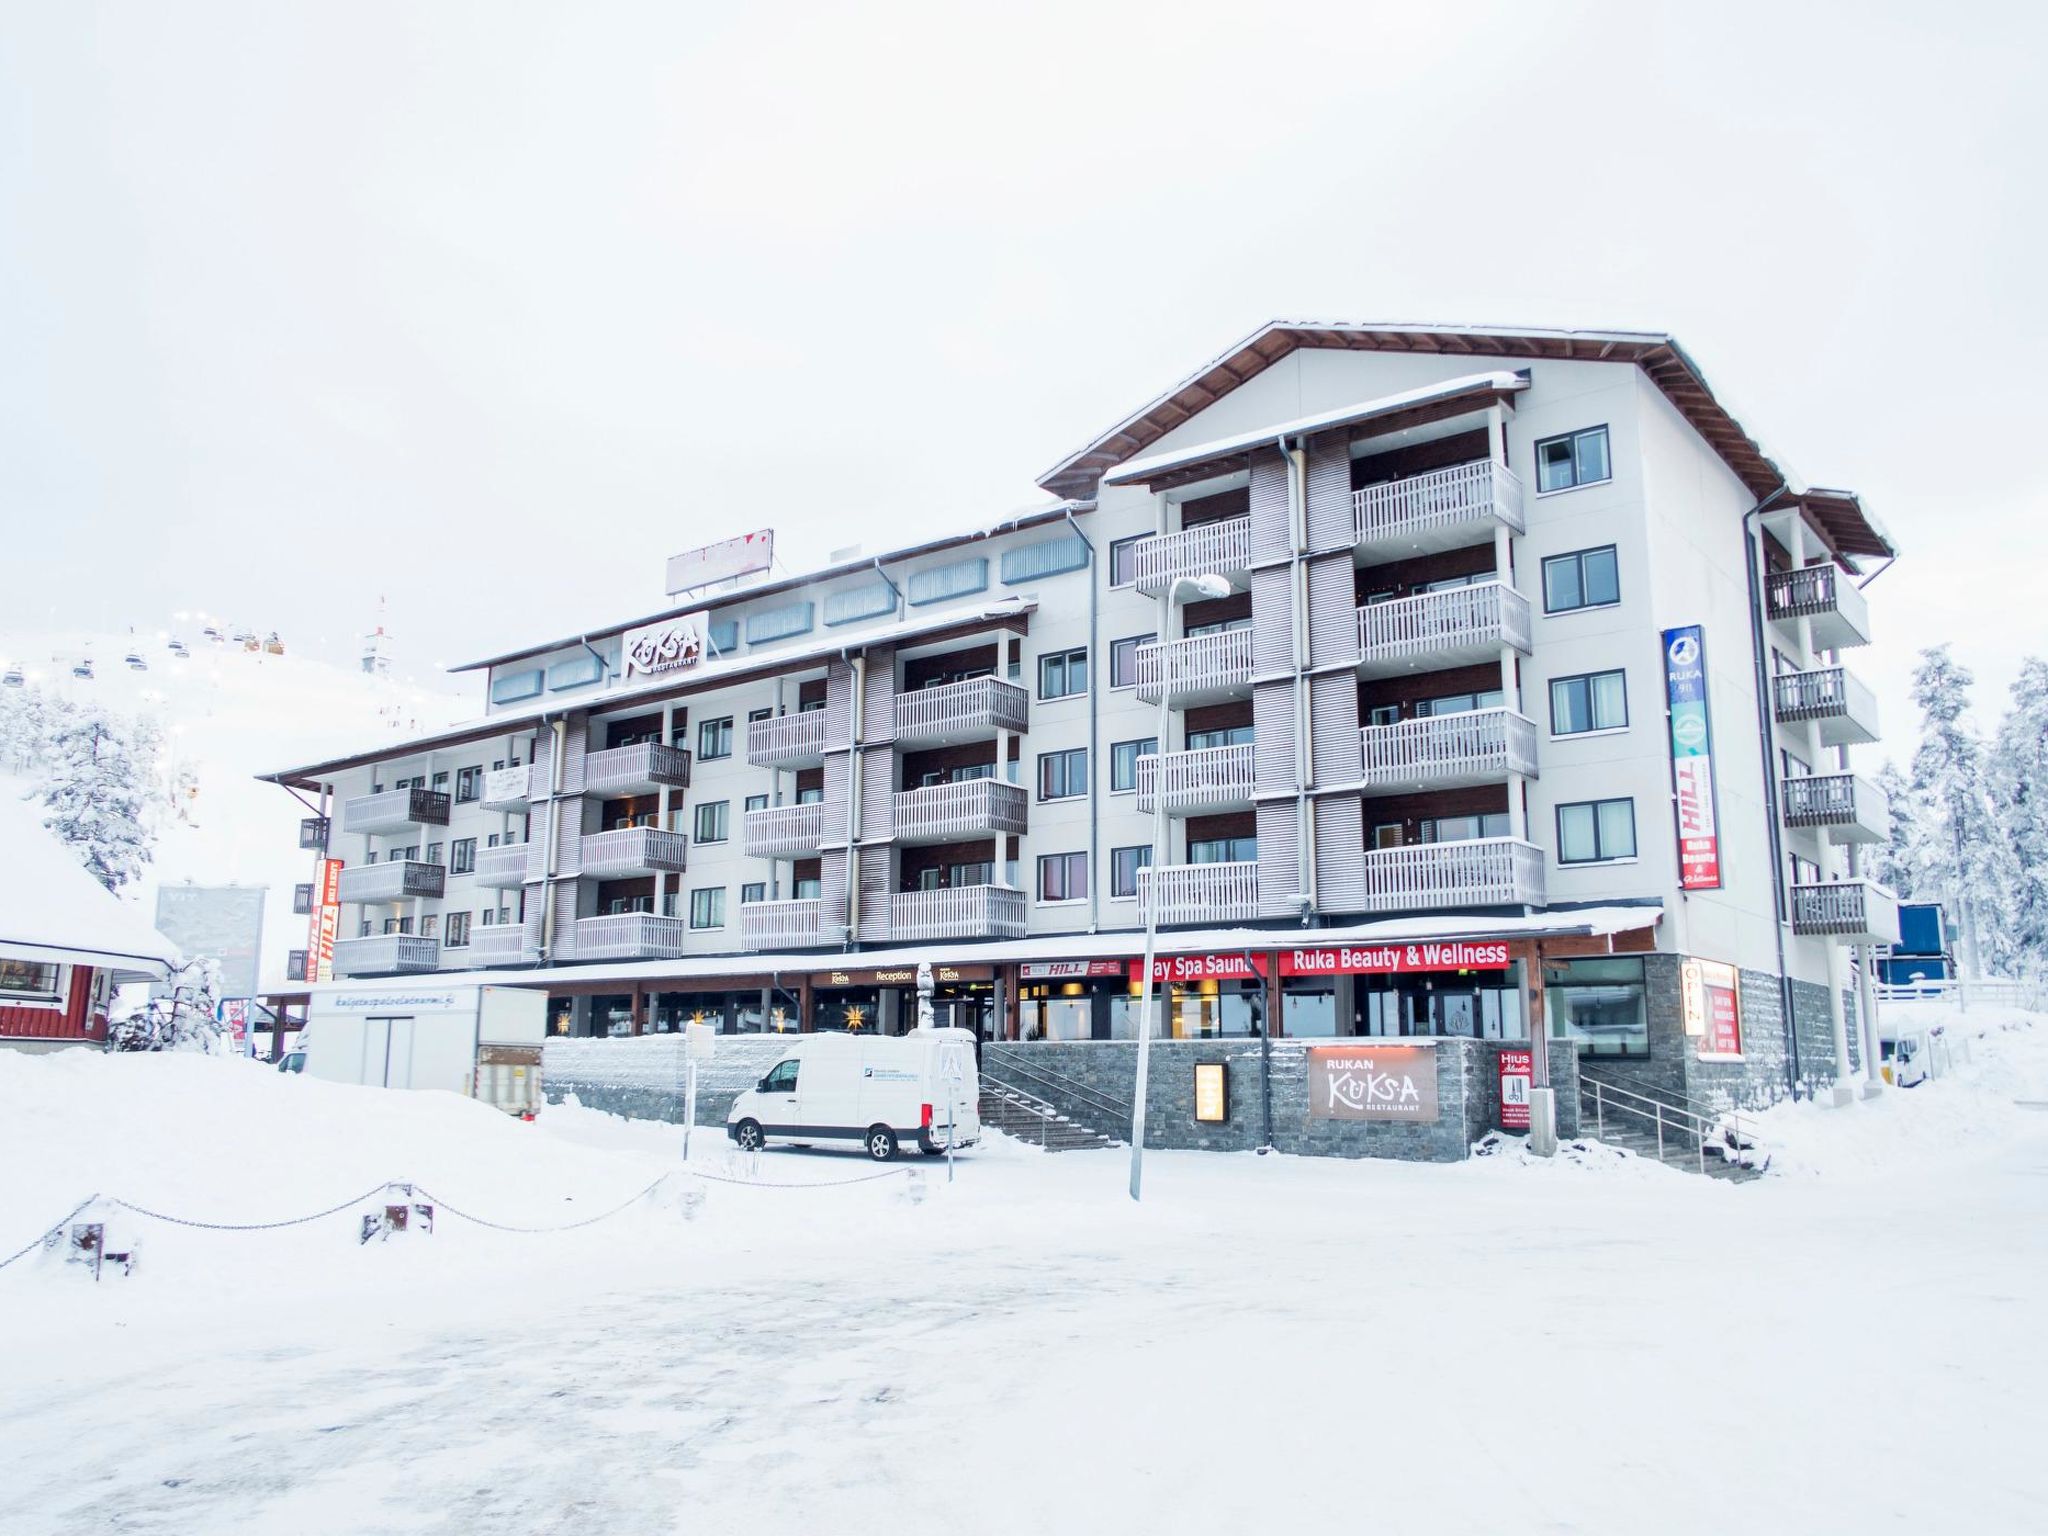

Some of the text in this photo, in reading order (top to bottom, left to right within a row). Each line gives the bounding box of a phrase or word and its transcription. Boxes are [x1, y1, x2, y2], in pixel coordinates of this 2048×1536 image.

[1669, 671, 1703, 682] RUKA
[1679, 762, 1701, 832] HILL
[321, 909, 335, 960] HILL
[1294, 943, 1507, 974] Ruka Beauty & Wellness
[1048, 963, 1083, 976] HILL
[1153, 961, 1171, 981] ay
[1175, 957, 1203, 980] Spa
[876, 970, 912, 982] Reception
[1326, 1059, 1374, 1070] RUKAN
[1501, 1064, 1531, 1074] Studio
[1327, 1070, 1420, 1111] KUKSA
[1365, 1103, 1420, 1113] RESTAURANT
